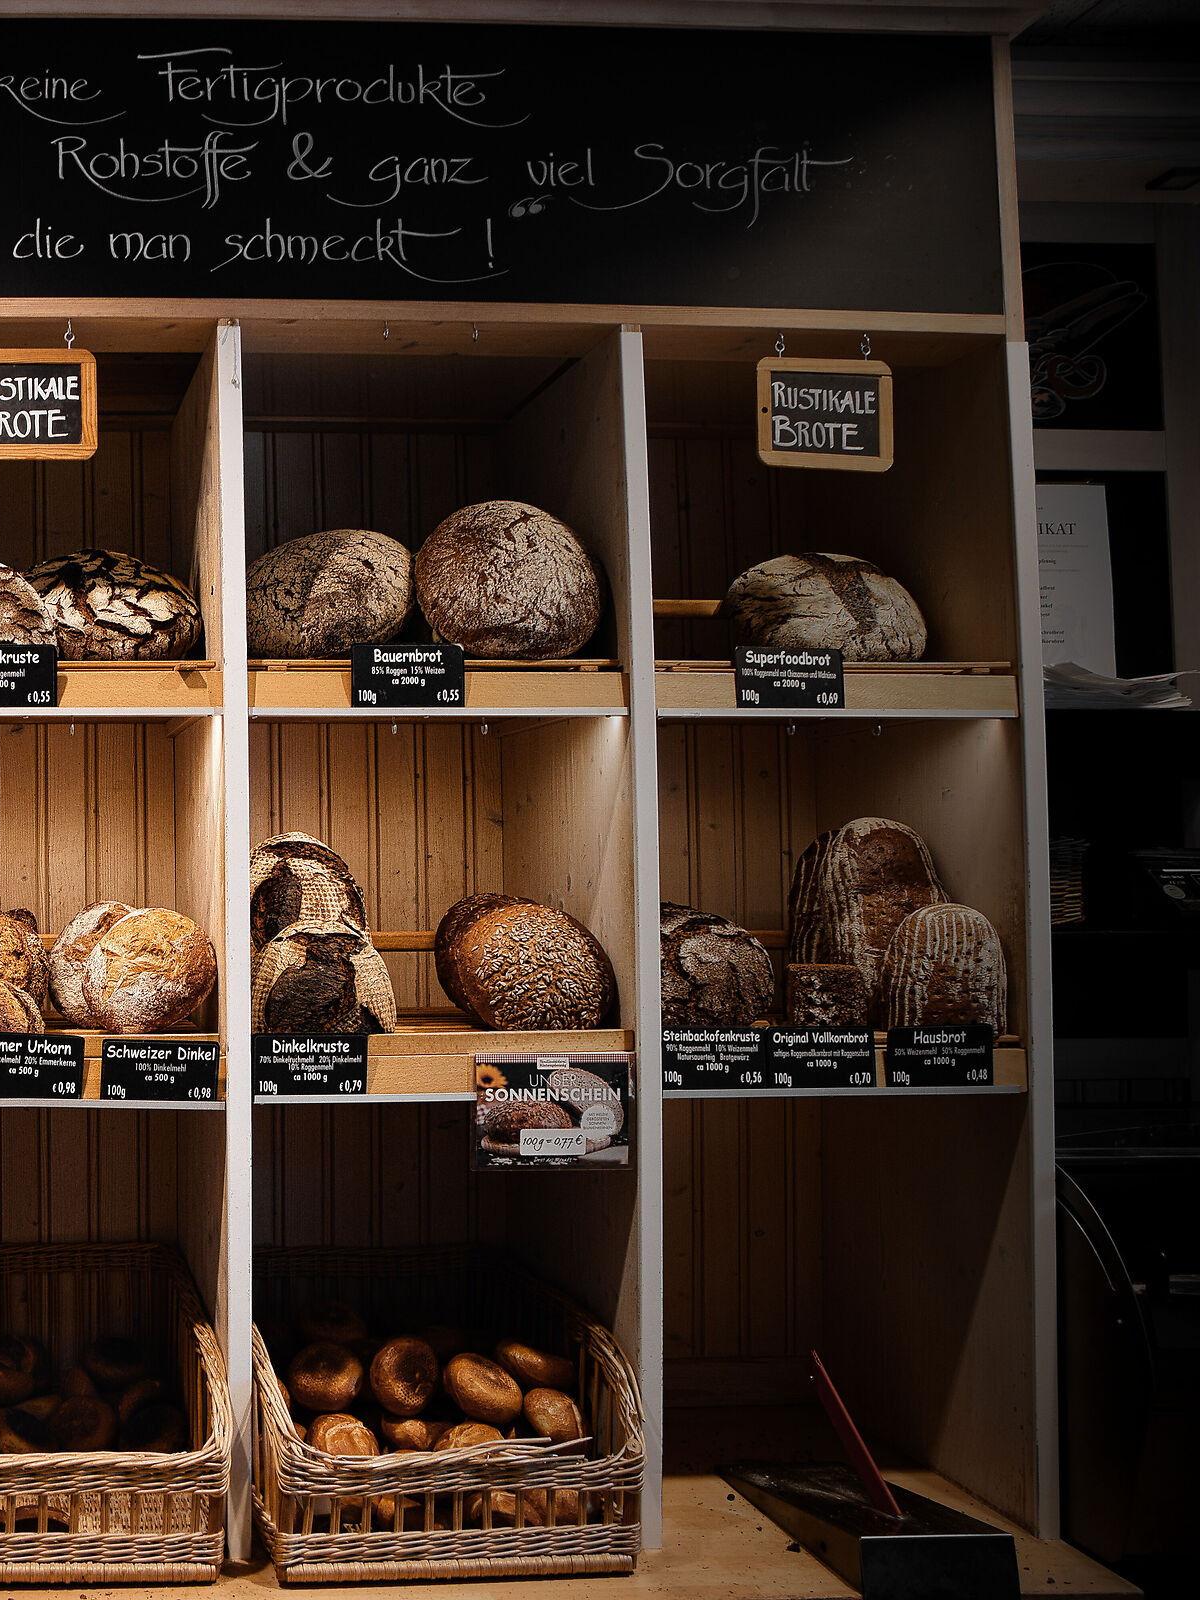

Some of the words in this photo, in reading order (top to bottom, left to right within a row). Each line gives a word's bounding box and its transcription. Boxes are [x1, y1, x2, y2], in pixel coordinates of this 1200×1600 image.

[137, 48, 531, 128] Fertigprodukte
[50, 130, 260, 209] Rohstoffe
[286, 132, 333, 181] &
[326, 155, 490, 207] ganz
[526, 147, 596, 188] viel
[568, 143, 854, 229] Sorgfalt
[12, 217, 86, 260] die
[109, 231, 192, 261] man
[210, 217, 509, 283] schmeckt
[772, 382, 876, 414] RUSTIKALE
[772, 415, 864, 450] BROTE
[374, 649, 442, 662] Bauernbrot
[746, 651, 831, 667] Superfoodbrot
[372, 666, 384, 674] 85%
[386, 666, 407, 675] Roggen
[411, 666, 423, 674] 15%
[425, 666, 445, 674] Weizen
[358, 690, 376, 704] 100g
[742, 689, 759, 704] 100g
[663, 1030, 760, 1042] Steinbackofenkruste
[773, 1032, 809, 1046] Original
[812, 1032, 868, 1043] Vollkornbrot
[914, 1030, 966, 1044] Hausbrot
[28, 1040, 72, 1055] Urkorn
[107, 1045, 172, 1060] Schweizer
[178, 1047, 215, 1060] Dinkel
[272, 1039, 349, 1053] Dinkelkruste
[19, 1066, 32, 1074] 500
[135, 1063, 151, 1071] 100%
[154, 1064, 186, 1072] Dinkelmehl
[529, 1074, 577, 1087] UNSER
[664, 1071, 682, 1085] 100g
[774, 1073, 792, 1087] 100g
[893, 1071, 910, 1085] 100g
[108, 1085, 126, 1099] 100g
[259, 1081, 277, 1094] 100g
[485, 1088, 621, 1102] SONNENSCHEIN
[523, 1136, 545, 1151] 100g
[554, 1136, 573, 1149] 0,77
[575, 1135, 583, 1145] €
